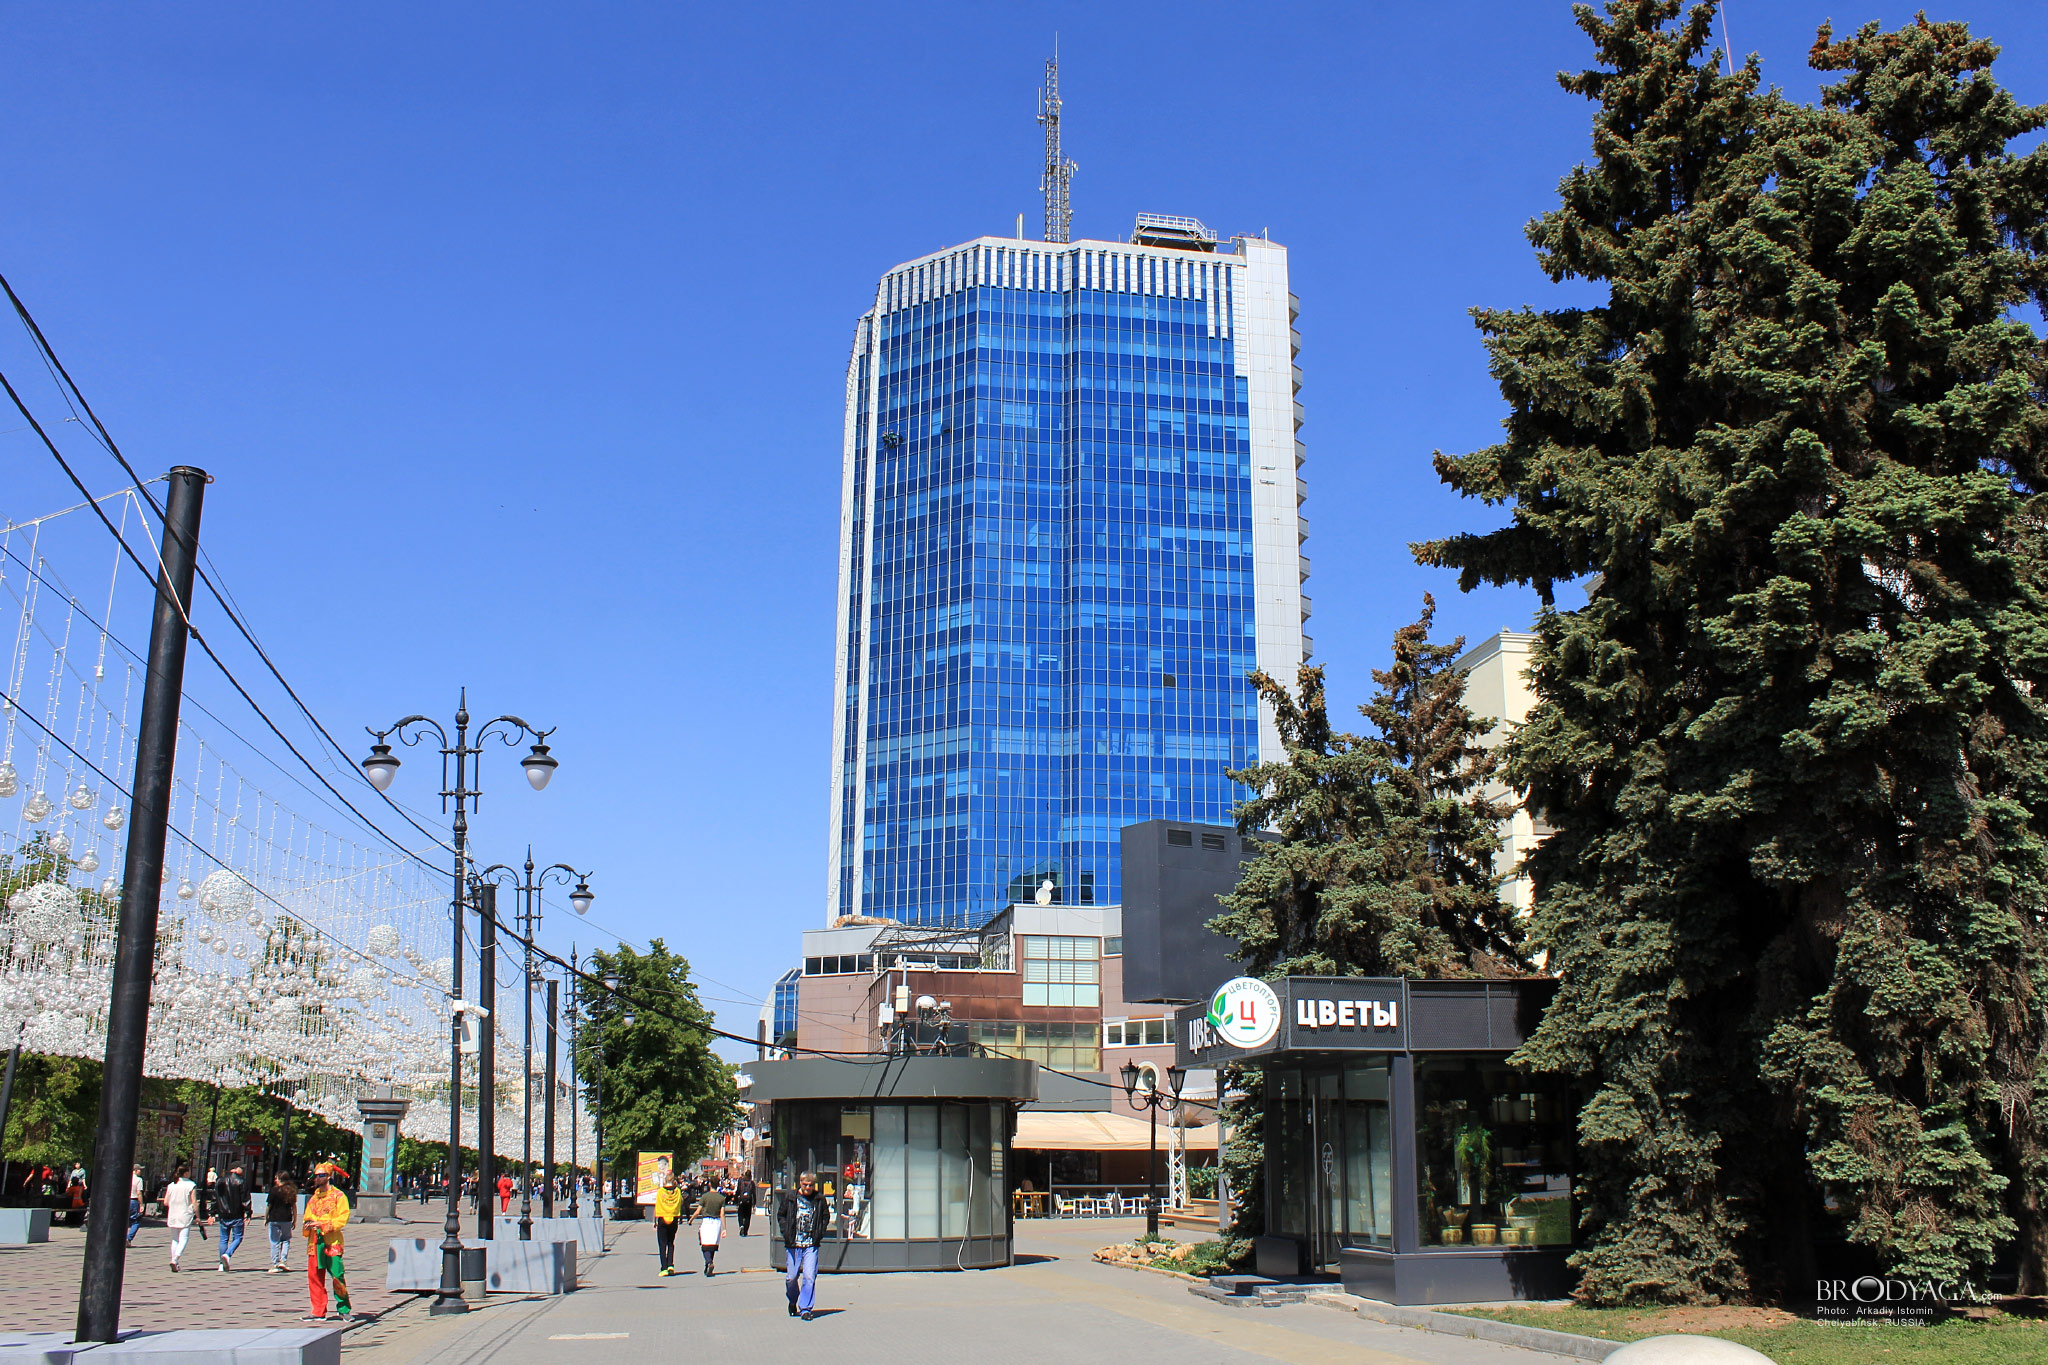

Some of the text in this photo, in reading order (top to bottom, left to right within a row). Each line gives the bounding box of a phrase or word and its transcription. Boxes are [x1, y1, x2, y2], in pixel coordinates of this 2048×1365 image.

[1228, 981, 1277, 1018] ЦВЕТОПТОРГ
[1240, 1000, 1256, 1024] Ц
[1297, 999, 1397, 1028] ЦВЕТЫ
[1189, 1016, 1224, 1055] ЦВЕ
